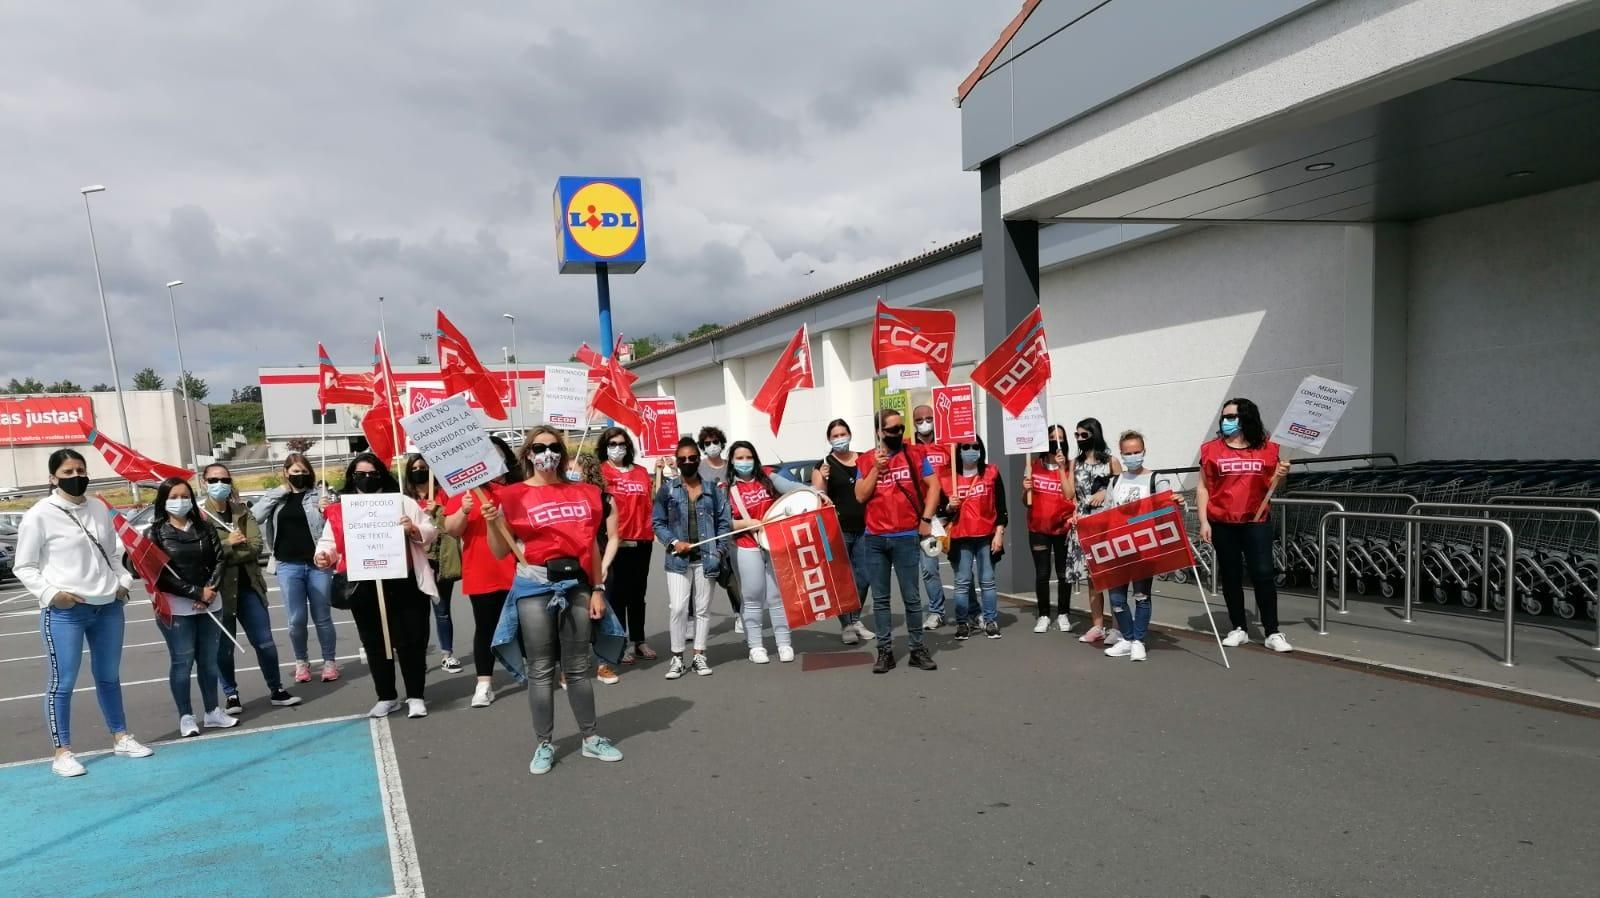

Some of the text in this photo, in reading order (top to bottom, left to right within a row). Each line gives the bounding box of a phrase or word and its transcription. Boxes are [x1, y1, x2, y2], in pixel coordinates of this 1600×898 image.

[569, 205, 637, 231] LIDL
[25, 407, 84, 429] justas!
[417, 404, 450, 424] LIDL NO
[412, 410, 471, 442] GARANTIZA LA
[1291, 425, 1319, 437] CCOO
[419, 427, 466, 454] SEGURIDAD
[466, 421, 480, 432] DE
[430, 455, 441, 464] LA
[442, 435, 483, 458] PLANTILLA
[449, 463, 485, 484] CCOO
[1222, 462, 1263, 472] CCOO
[452, 471, 489, 491] servizos
[617, 481, 644, 493] CCOO
[350, 499, 394, 508] PROTOCOLO
[534, 505, 587, 524] CCOO
[790, 522, 832, 614] CCOO
